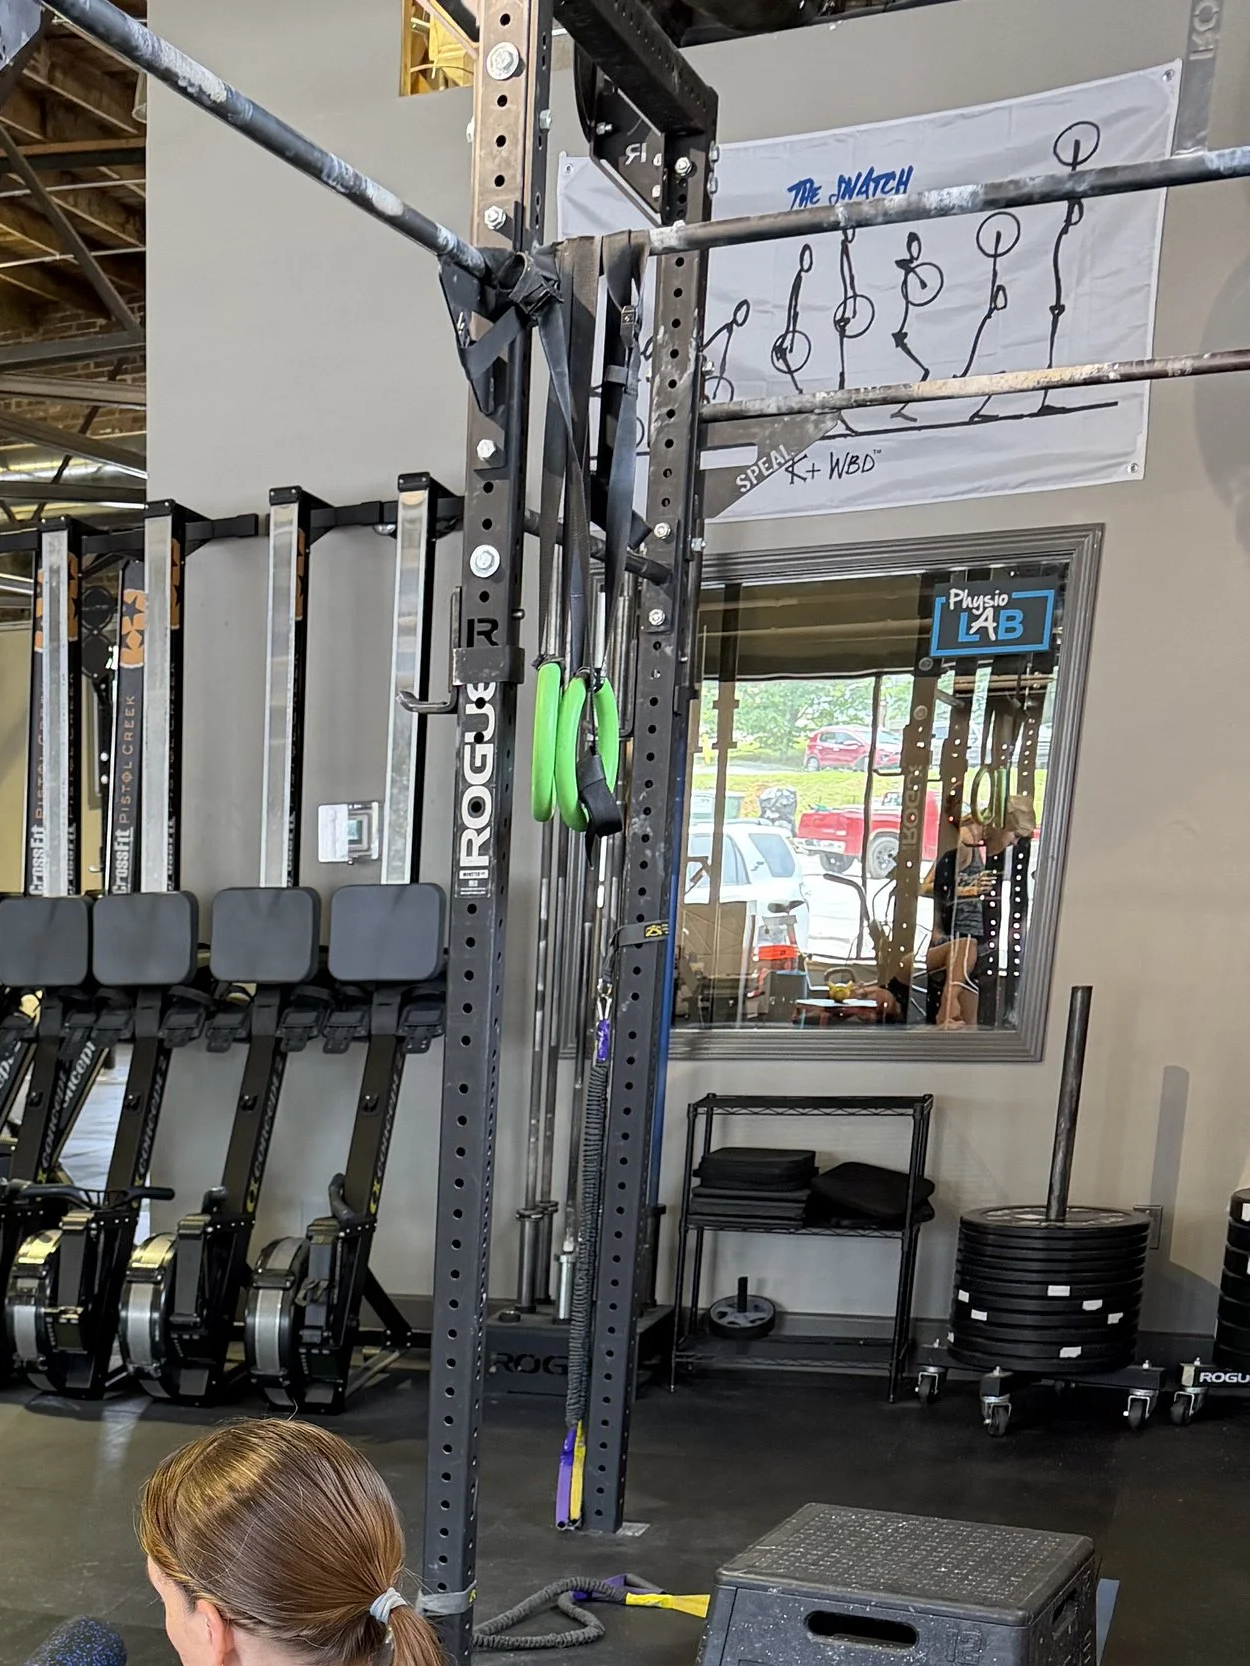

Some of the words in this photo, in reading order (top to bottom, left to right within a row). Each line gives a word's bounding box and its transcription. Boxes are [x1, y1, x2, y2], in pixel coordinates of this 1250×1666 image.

[787, 177, 822, 211] THE
[949, 588, 1008, 615] Physio
[958, 607, 1024, 643] LAB
[121, 695, 135, 755] CREEK
[118, 761, 135, 824] PISTOL
[112, 828, 134, 895] CrossFit
[1200, 1372, 1250, 1383] ROGU
